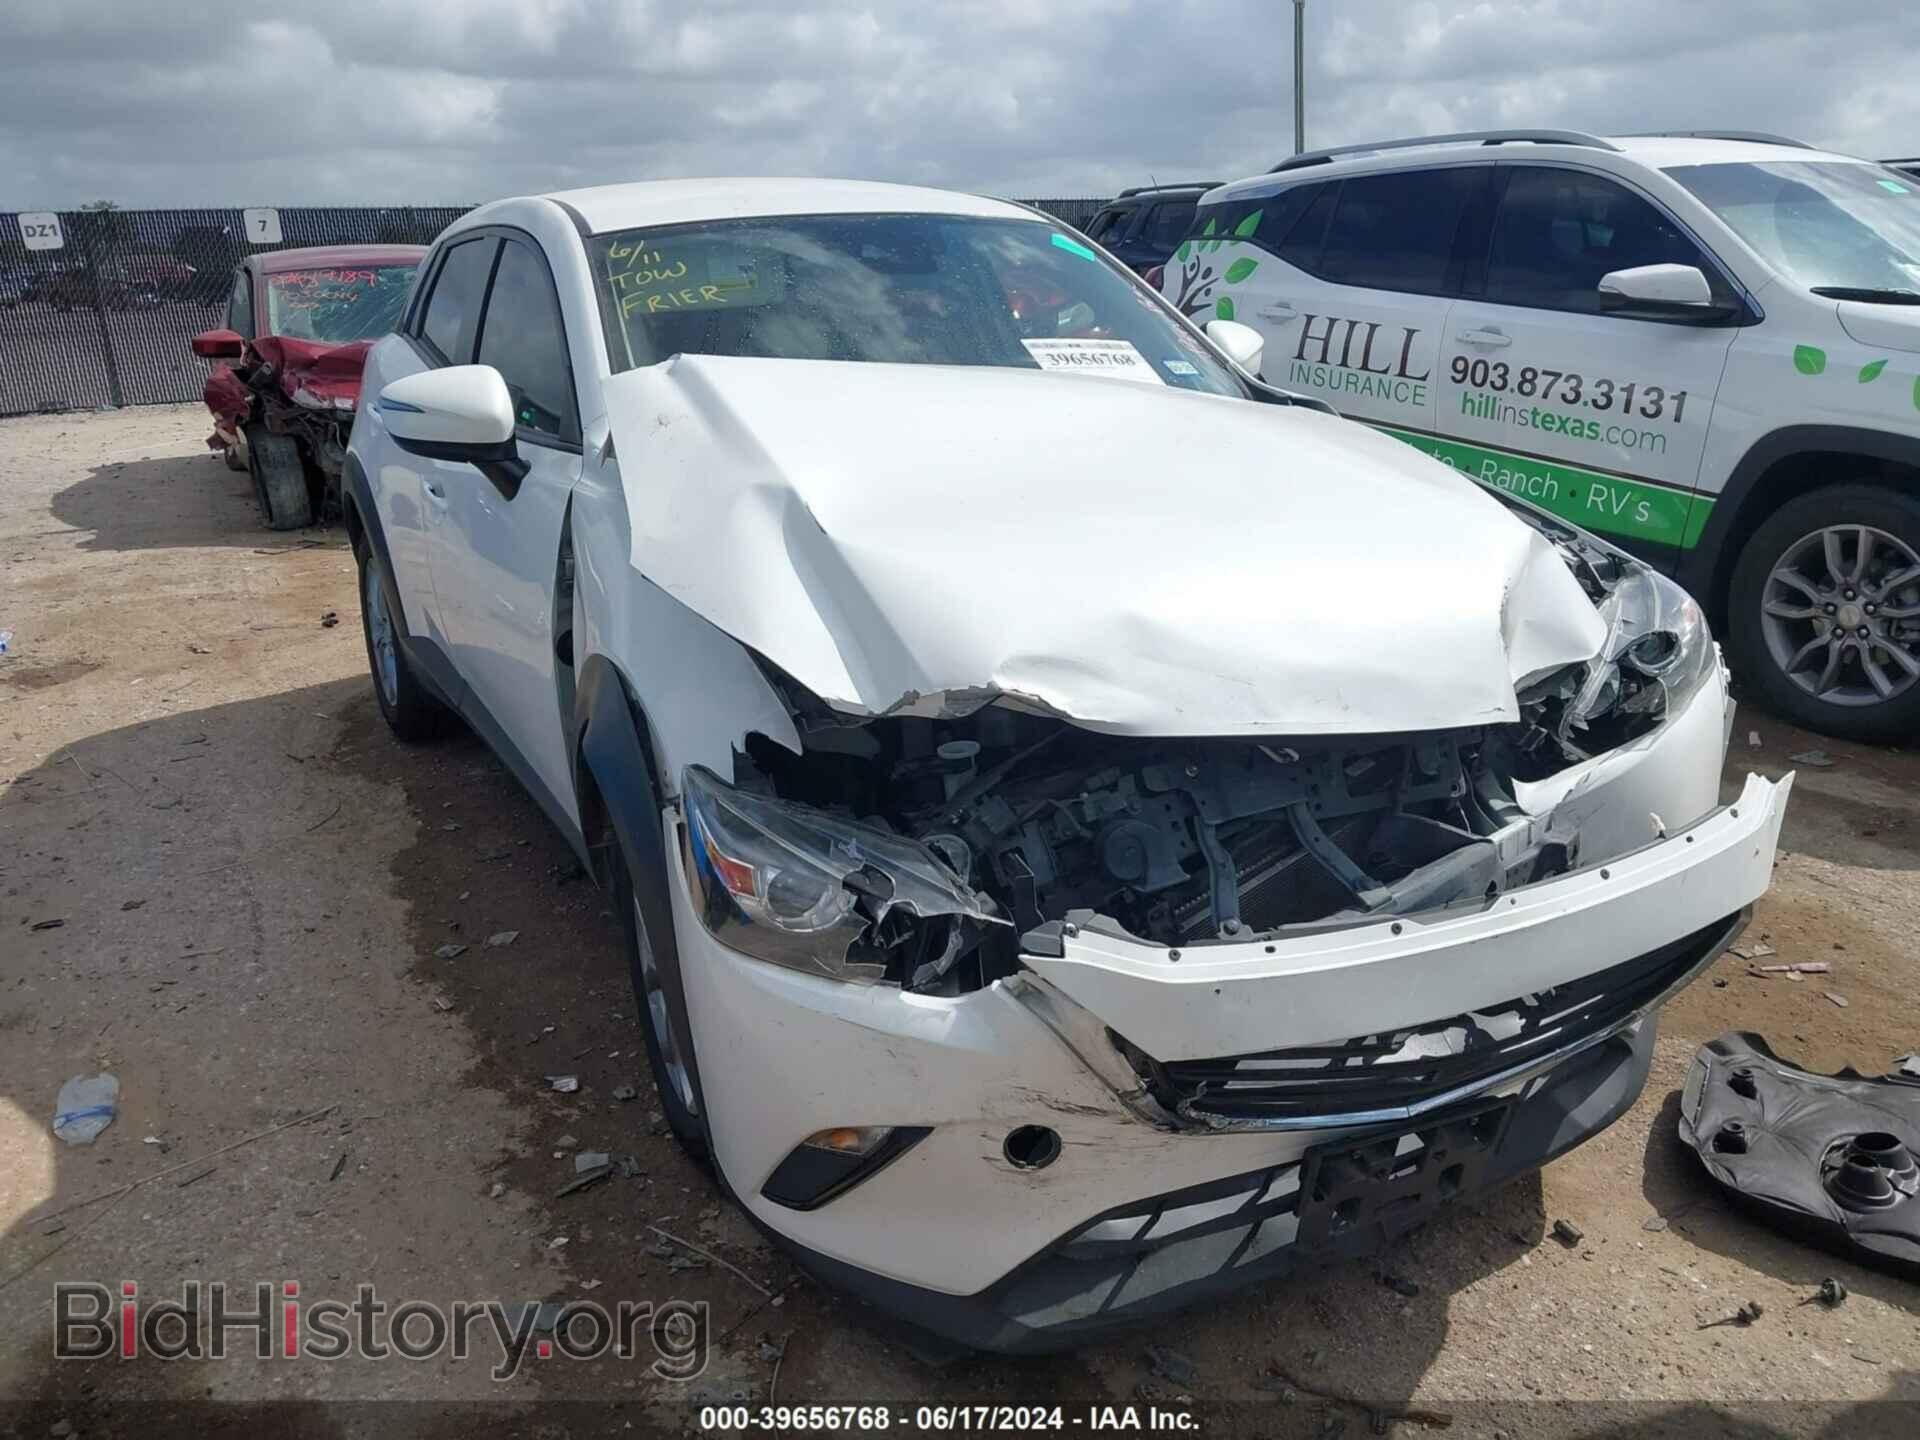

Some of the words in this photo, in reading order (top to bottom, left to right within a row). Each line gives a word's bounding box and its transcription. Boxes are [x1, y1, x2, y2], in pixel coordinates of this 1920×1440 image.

[24, 224, 58, 238] DZ1
[257, 219, 268, 233] 7
[607, 261, 687, 289] TOW
[621, 284, 729, 320] FRIER
[1045, 352, 1135, 367] 39656768
[1293, 313, 1431, 382] HILL
[1288, 361, 1427, 407] INSURANCE
[1450, 355, 1688, 424] 903.873.3131
[1461, 390, 1667, 454] hillinstexas.com
[1479, 459, 1559, 500] Ranch
